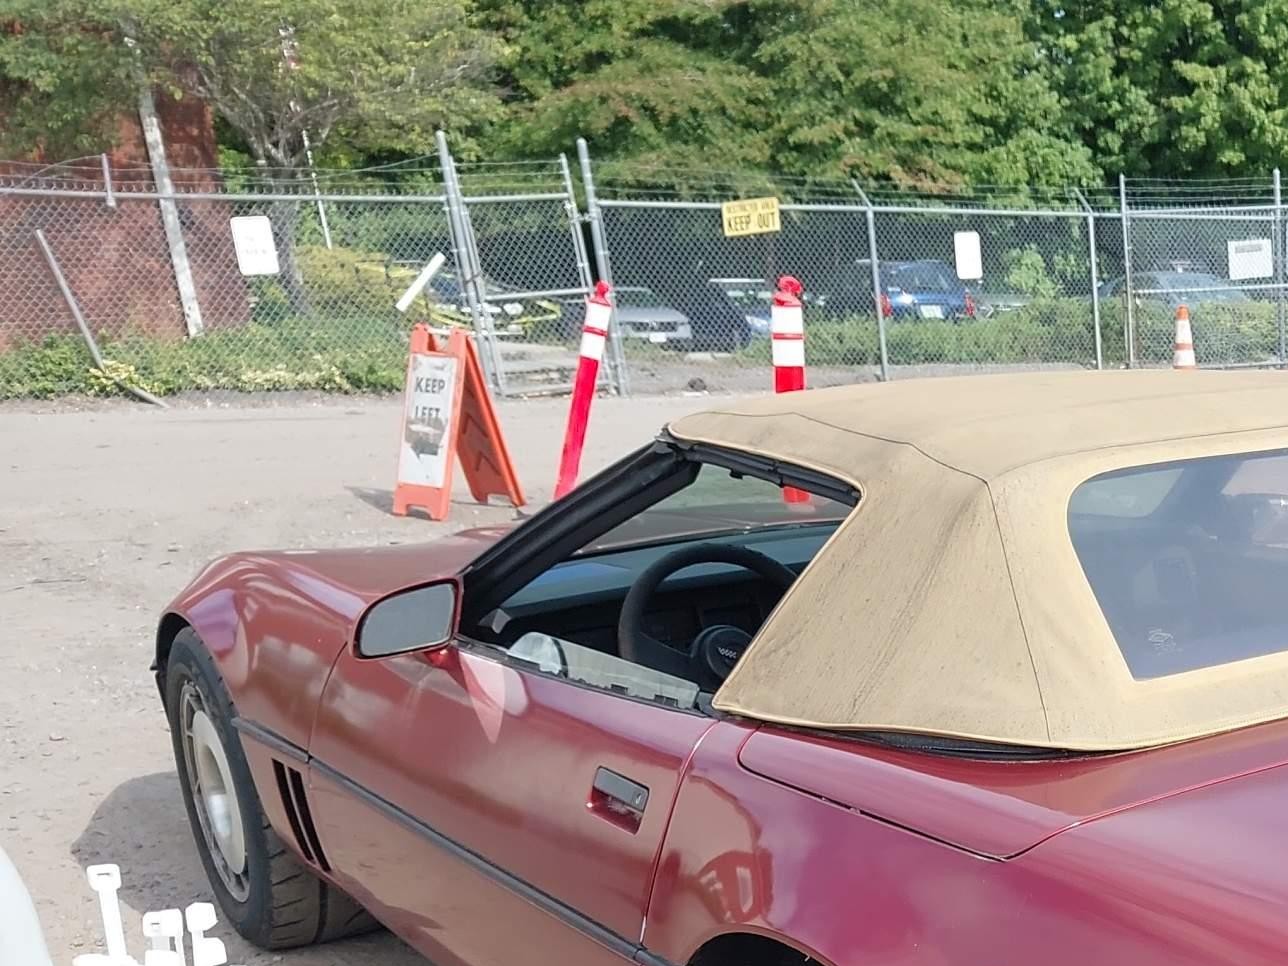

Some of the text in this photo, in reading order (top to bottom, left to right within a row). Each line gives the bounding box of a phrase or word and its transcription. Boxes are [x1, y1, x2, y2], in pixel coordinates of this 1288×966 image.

[727, 211, 775, 232] KEEP OUT
[415, 377, 446, 393] KEEP
